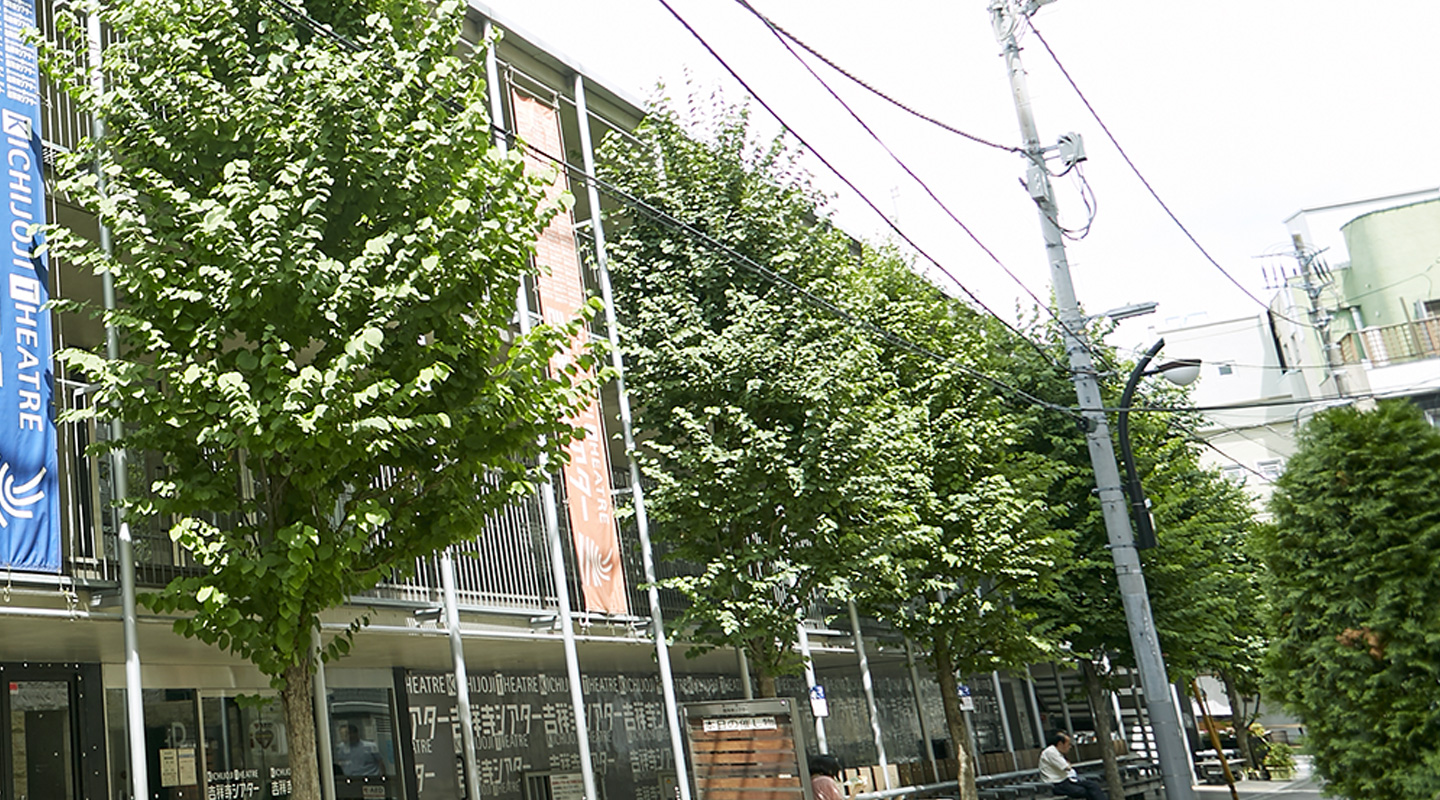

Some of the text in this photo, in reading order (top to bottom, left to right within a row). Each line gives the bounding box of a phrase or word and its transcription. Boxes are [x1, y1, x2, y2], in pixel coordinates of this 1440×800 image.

[2, 108, 35, 270] KICHIJOJI
[9, 272, 44, 432] THEATRE
[495, 673, 538, 695] THEATRE
